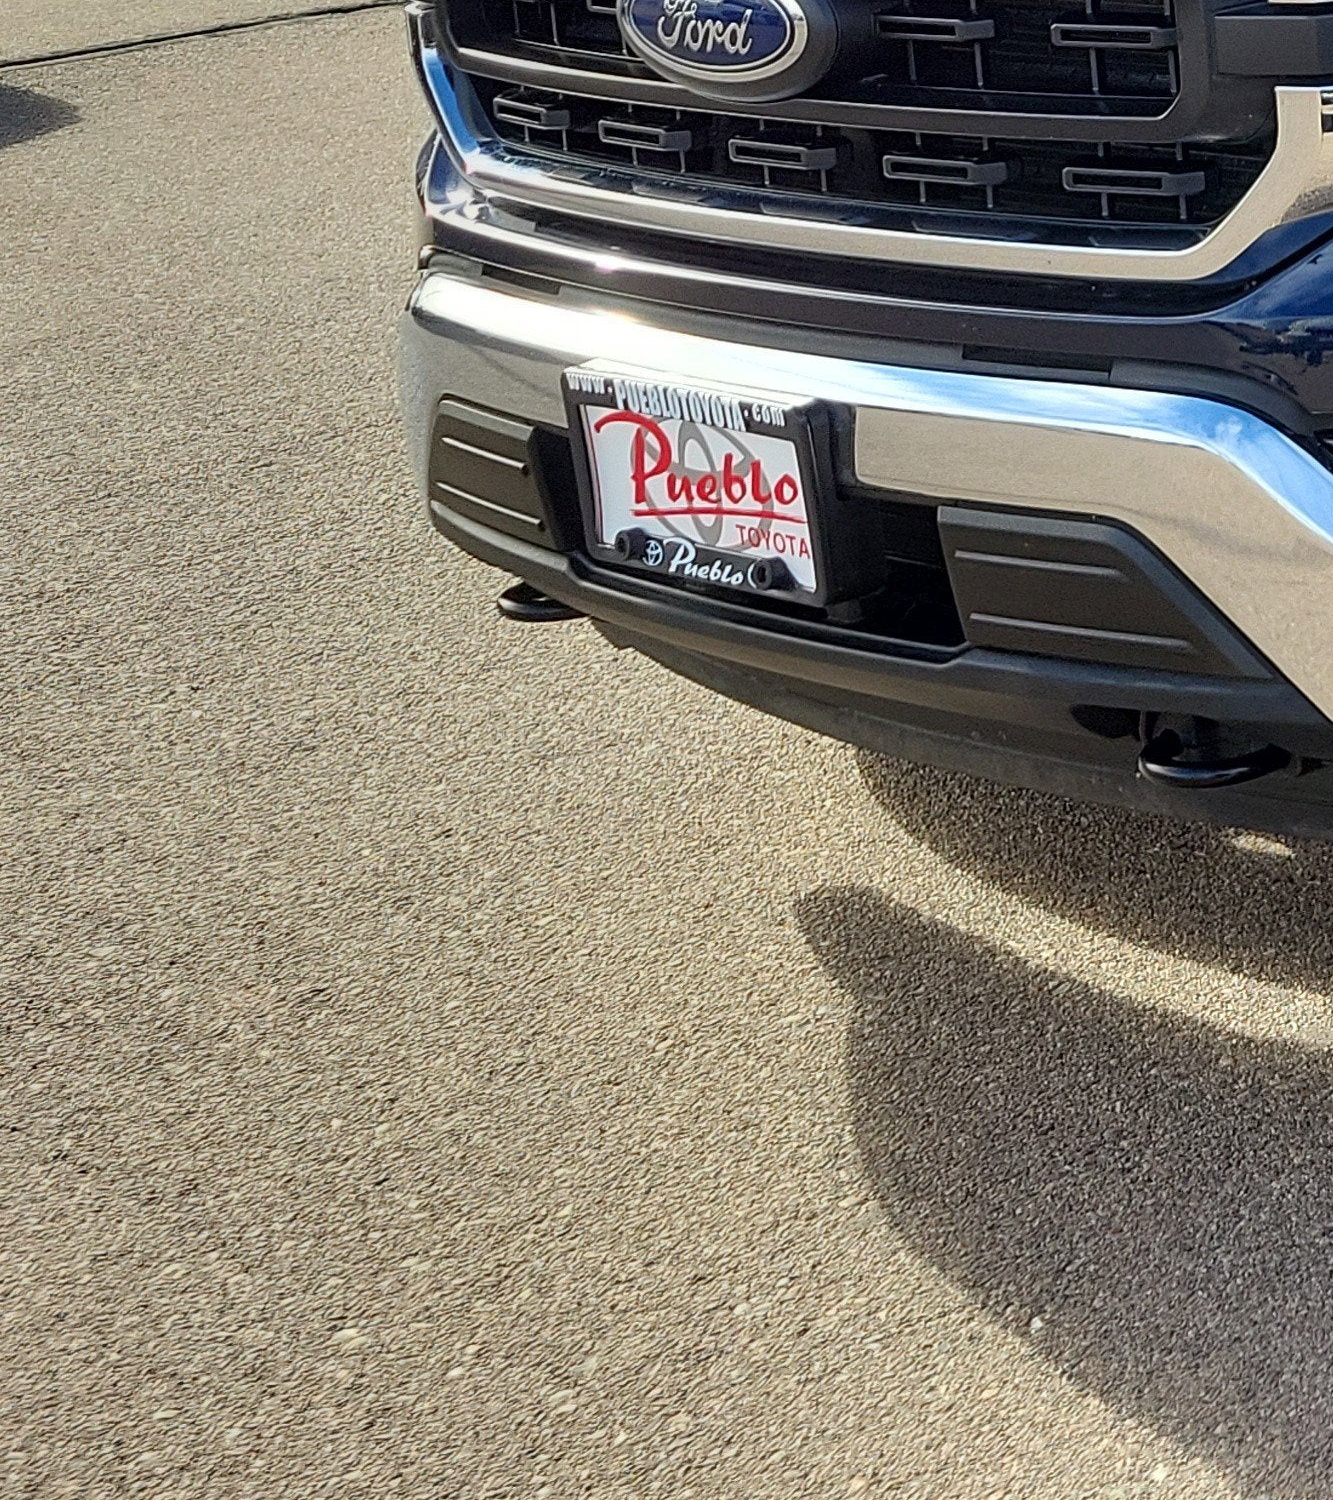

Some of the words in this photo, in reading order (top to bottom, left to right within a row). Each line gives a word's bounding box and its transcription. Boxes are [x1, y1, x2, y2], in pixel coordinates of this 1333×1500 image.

[594, 410, 799, 505] Pueblo
[663, 538, 744, 586] Pueblo
[735, 523, 811, 560] TOYOTA
